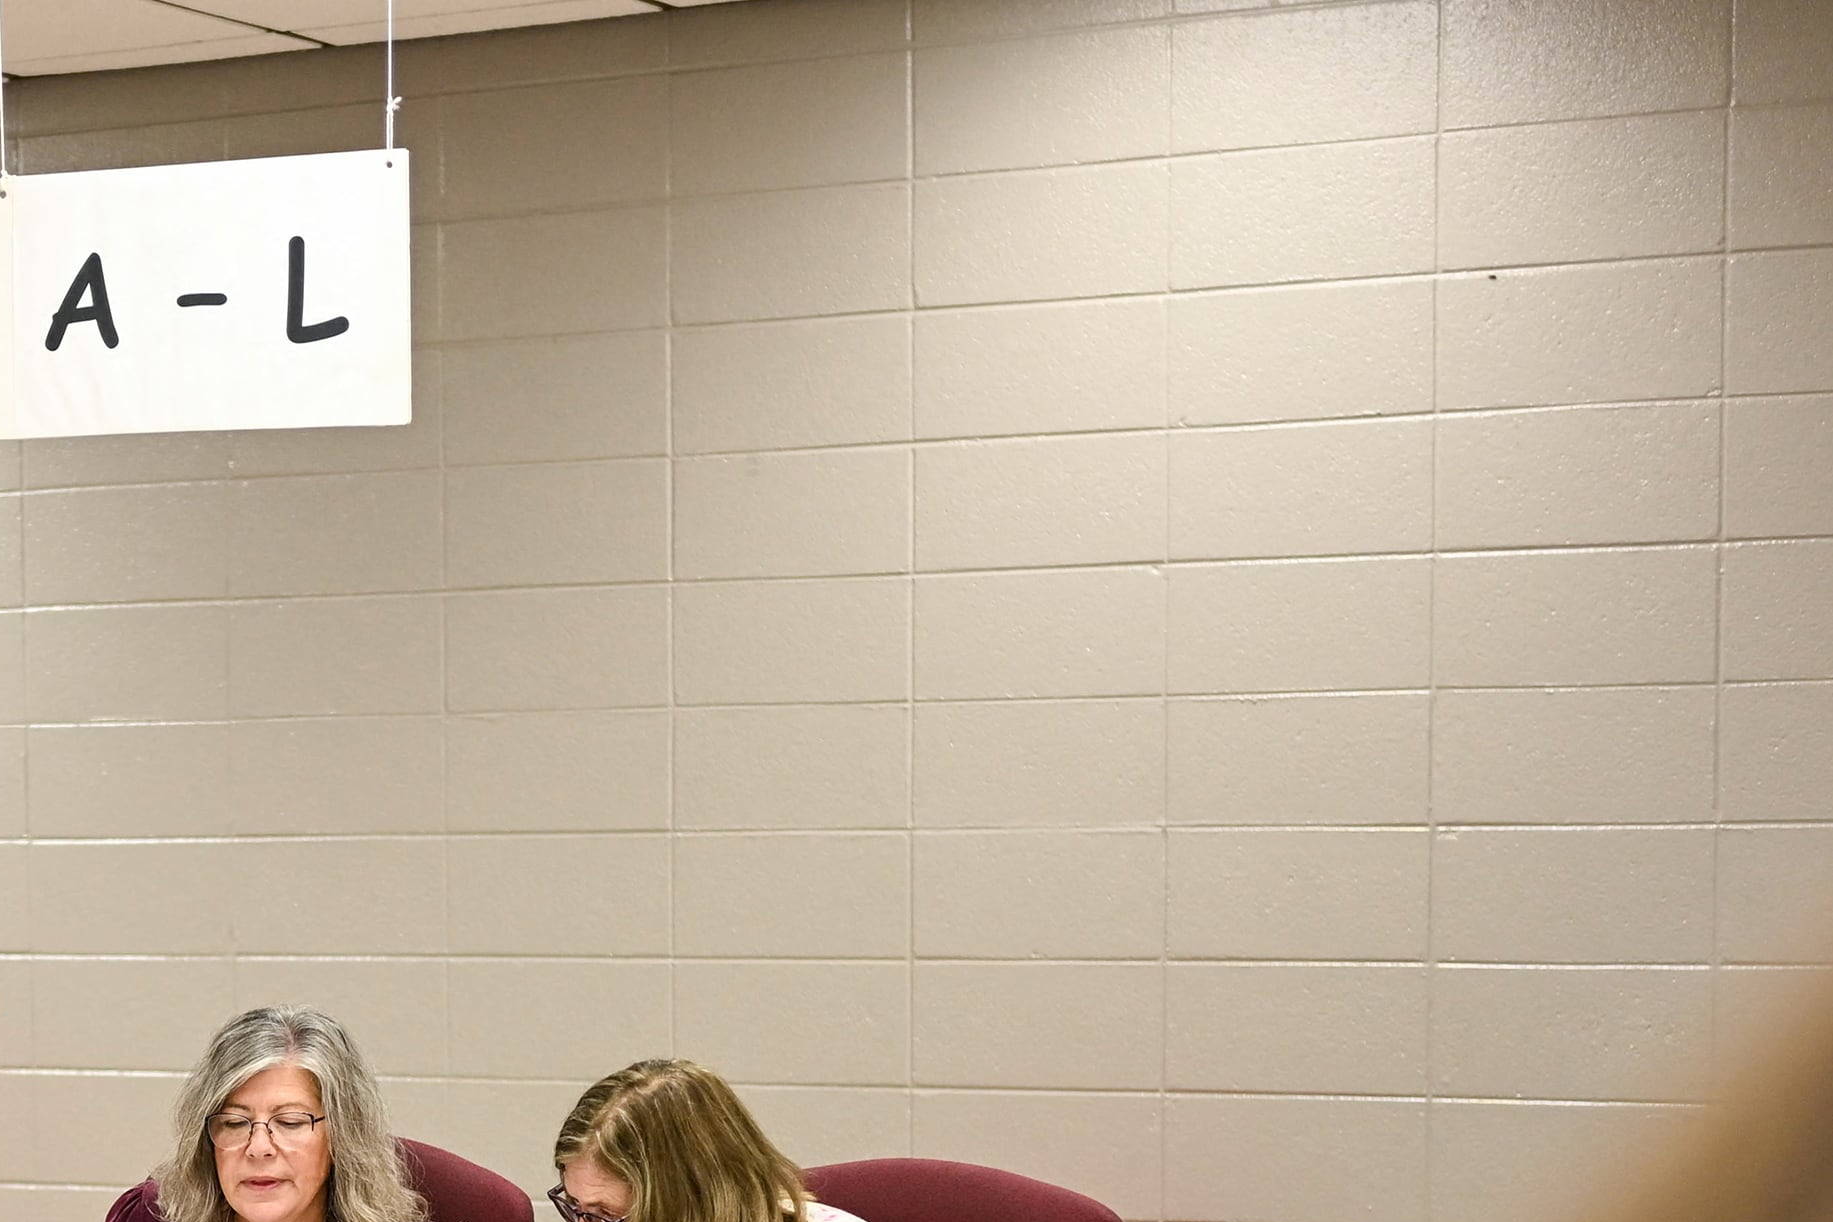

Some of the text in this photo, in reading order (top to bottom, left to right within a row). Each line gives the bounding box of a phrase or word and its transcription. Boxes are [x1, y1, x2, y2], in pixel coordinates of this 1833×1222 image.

[45, 235, 350, 352] A - L
